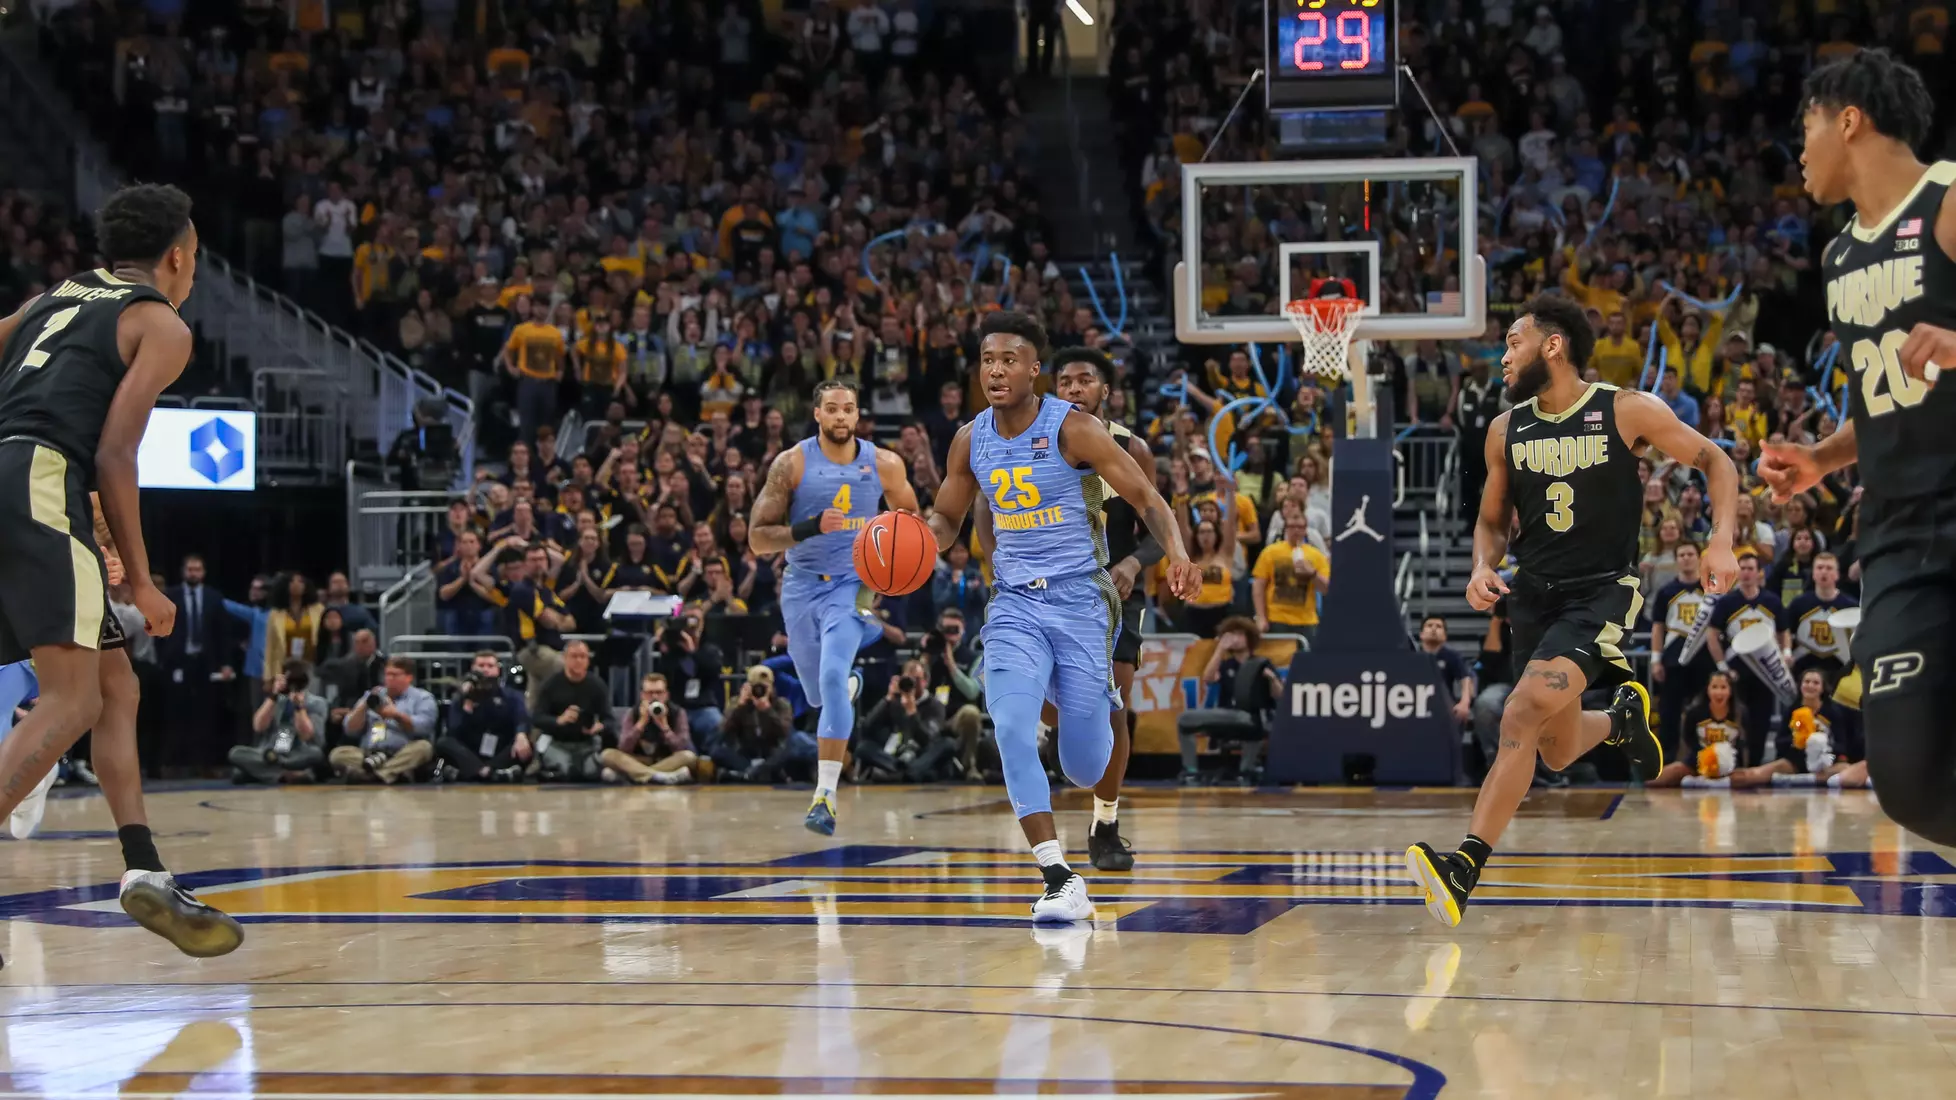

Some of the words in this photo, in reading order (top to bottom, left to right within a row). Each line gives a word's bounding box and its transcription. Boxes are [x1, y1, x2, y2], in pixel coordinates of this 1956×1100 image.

[1293, 10, 1371, 70] 29
[1827, 255, 1925, 327] PURDUE
[19, 304, 82, 371] 2
[1851, 328, 1930, 417] 20
[1511, 434, 1609, 477] PURDUE
[832, 484, 852, 514] 4
[989, 466, 1041, 509] 25
[1545, 482, 1574, 532] 3
[1291, 671, 1435, 729] meijer
[1869, 652, 1924, 694] P
